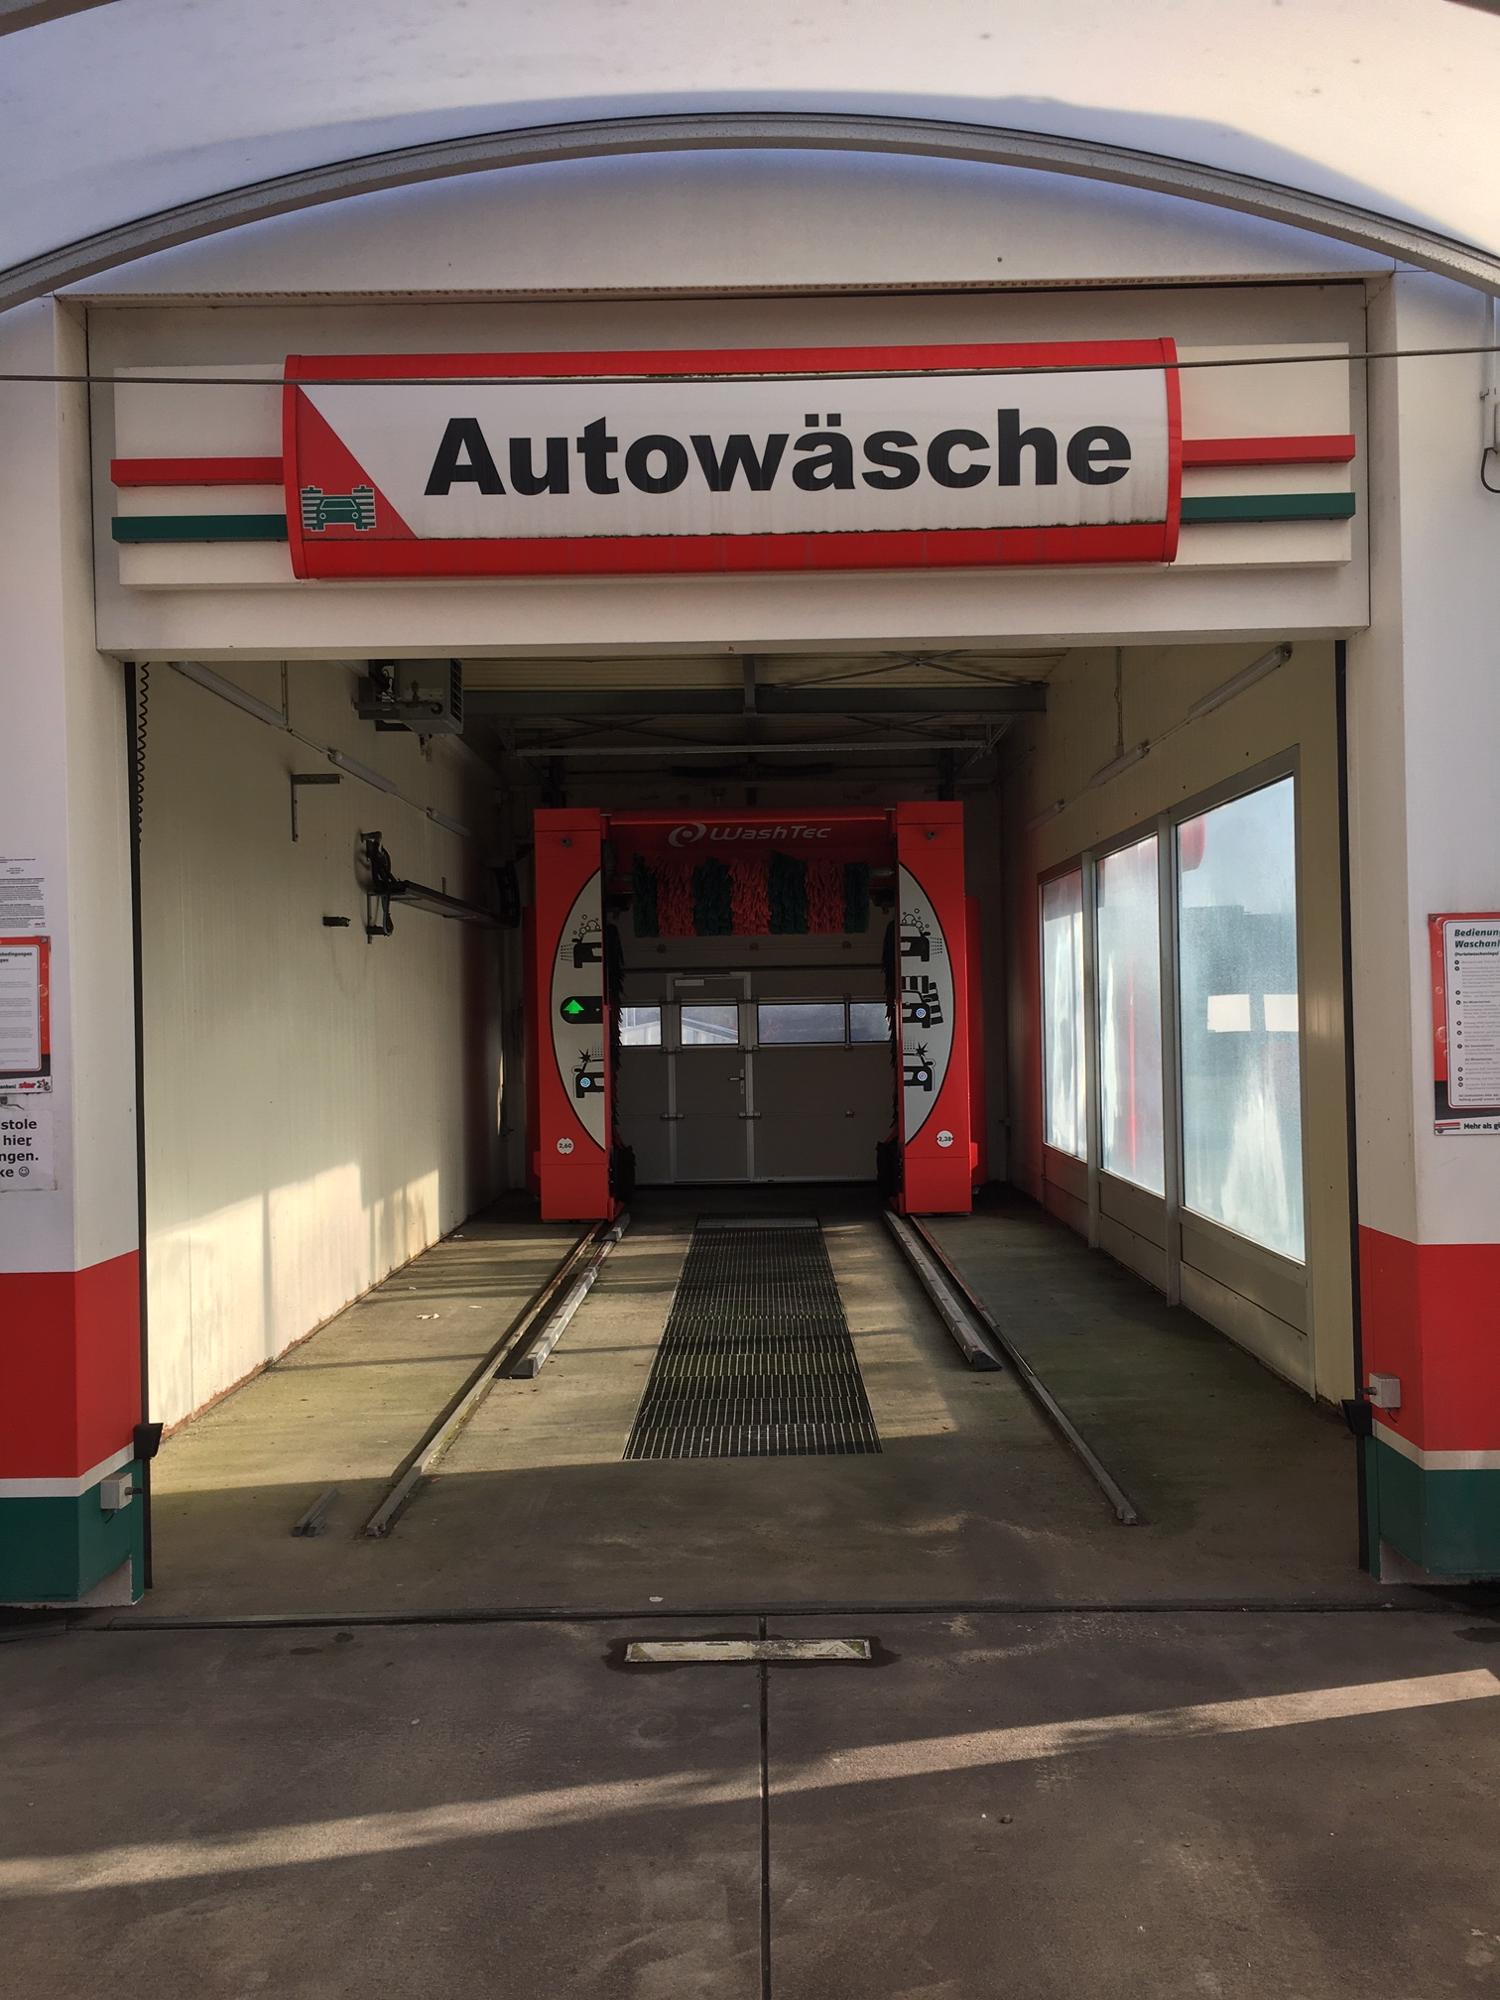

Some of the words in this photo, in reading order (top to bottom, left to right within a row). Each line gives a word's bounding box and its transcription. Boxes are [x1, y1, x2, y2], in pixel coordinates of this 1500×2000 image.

[423, 408, 1132, 496] Autowäsche
[710, 825, 832, 841] WashTec
[1454, 928, 1500, 937] Bedienun
